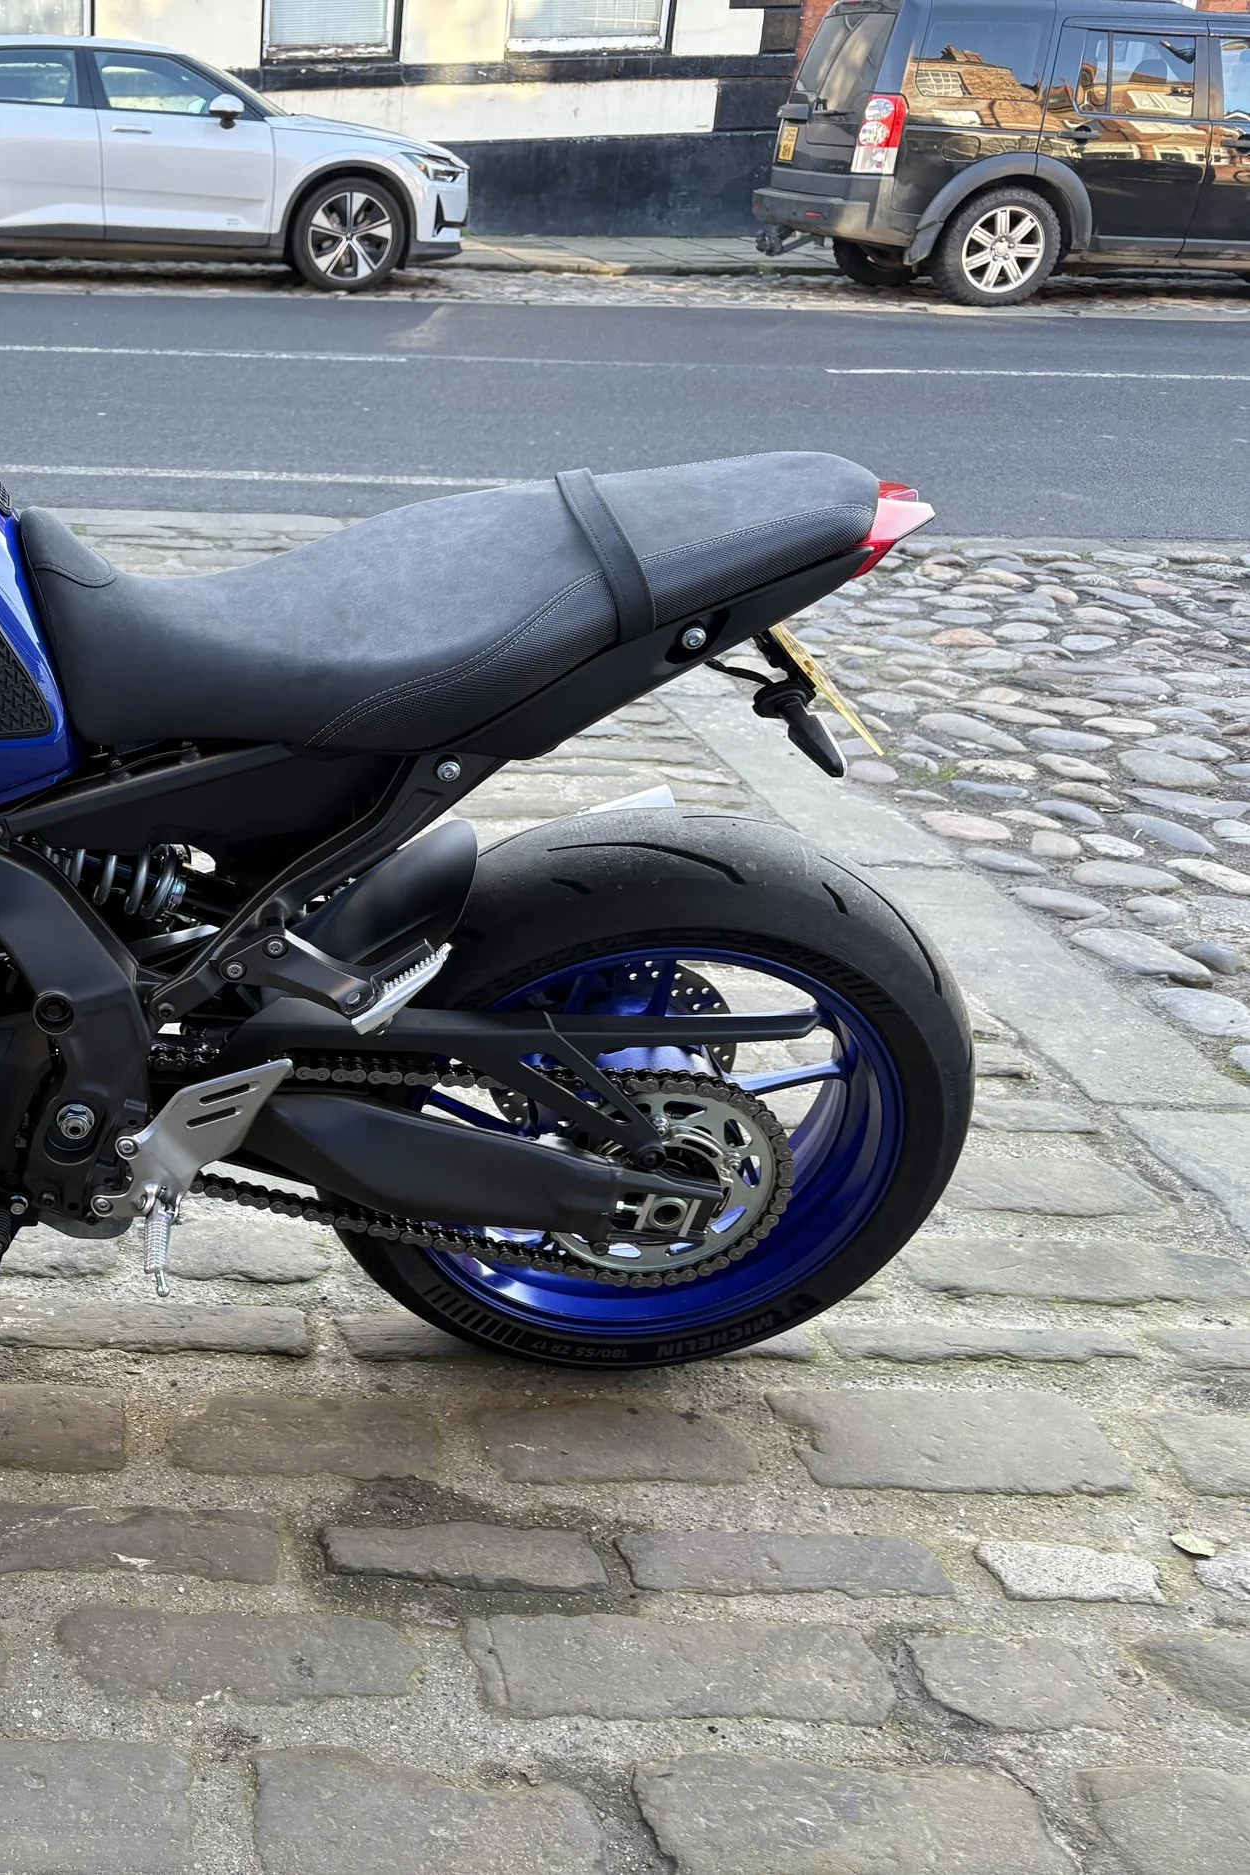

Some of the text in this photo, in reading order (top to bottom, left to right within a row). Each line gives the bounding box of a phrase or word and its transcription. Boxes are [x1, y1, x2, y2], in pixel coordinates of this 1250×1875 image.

[531, 1339, 629, 1359] 180/55 ZR 17
[656, 1314, 775, 1357] MICHELIN
